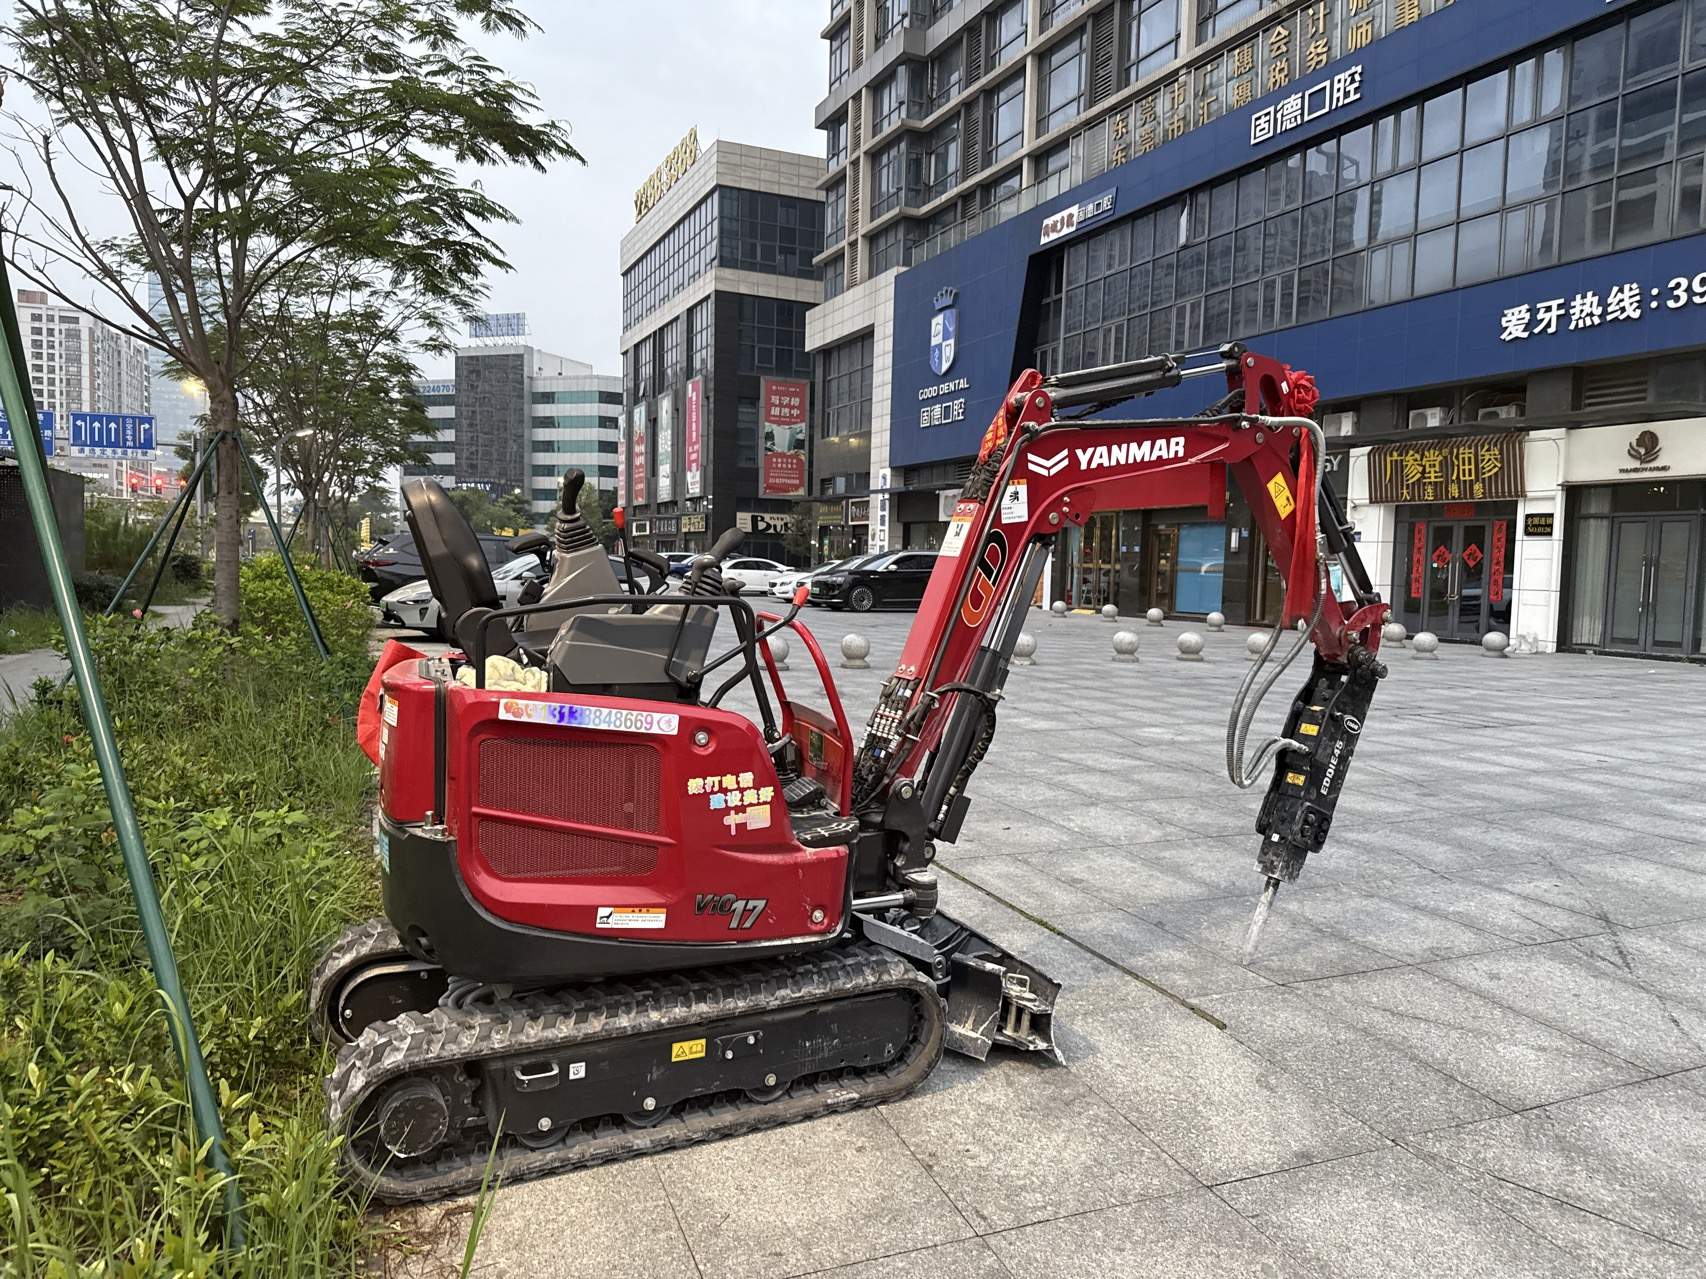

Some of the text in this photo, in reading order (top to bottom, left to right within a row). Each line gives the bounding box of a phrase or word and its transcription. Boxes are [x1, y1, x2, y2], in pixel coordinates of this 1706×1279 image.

[1250, 64, 1363, 146] 固德口腔
[918, 377, 970, 400] GOOD DENTAL
[920, 398, 965, 428] 固德口腔
[1075, 436, 1186, 471] YANMAR
[1401, 481, 1485, 501] 大连海参
[1320, 740, 1344, 796] EDDIE45
[709, 786, 775, 810] 建设美好
